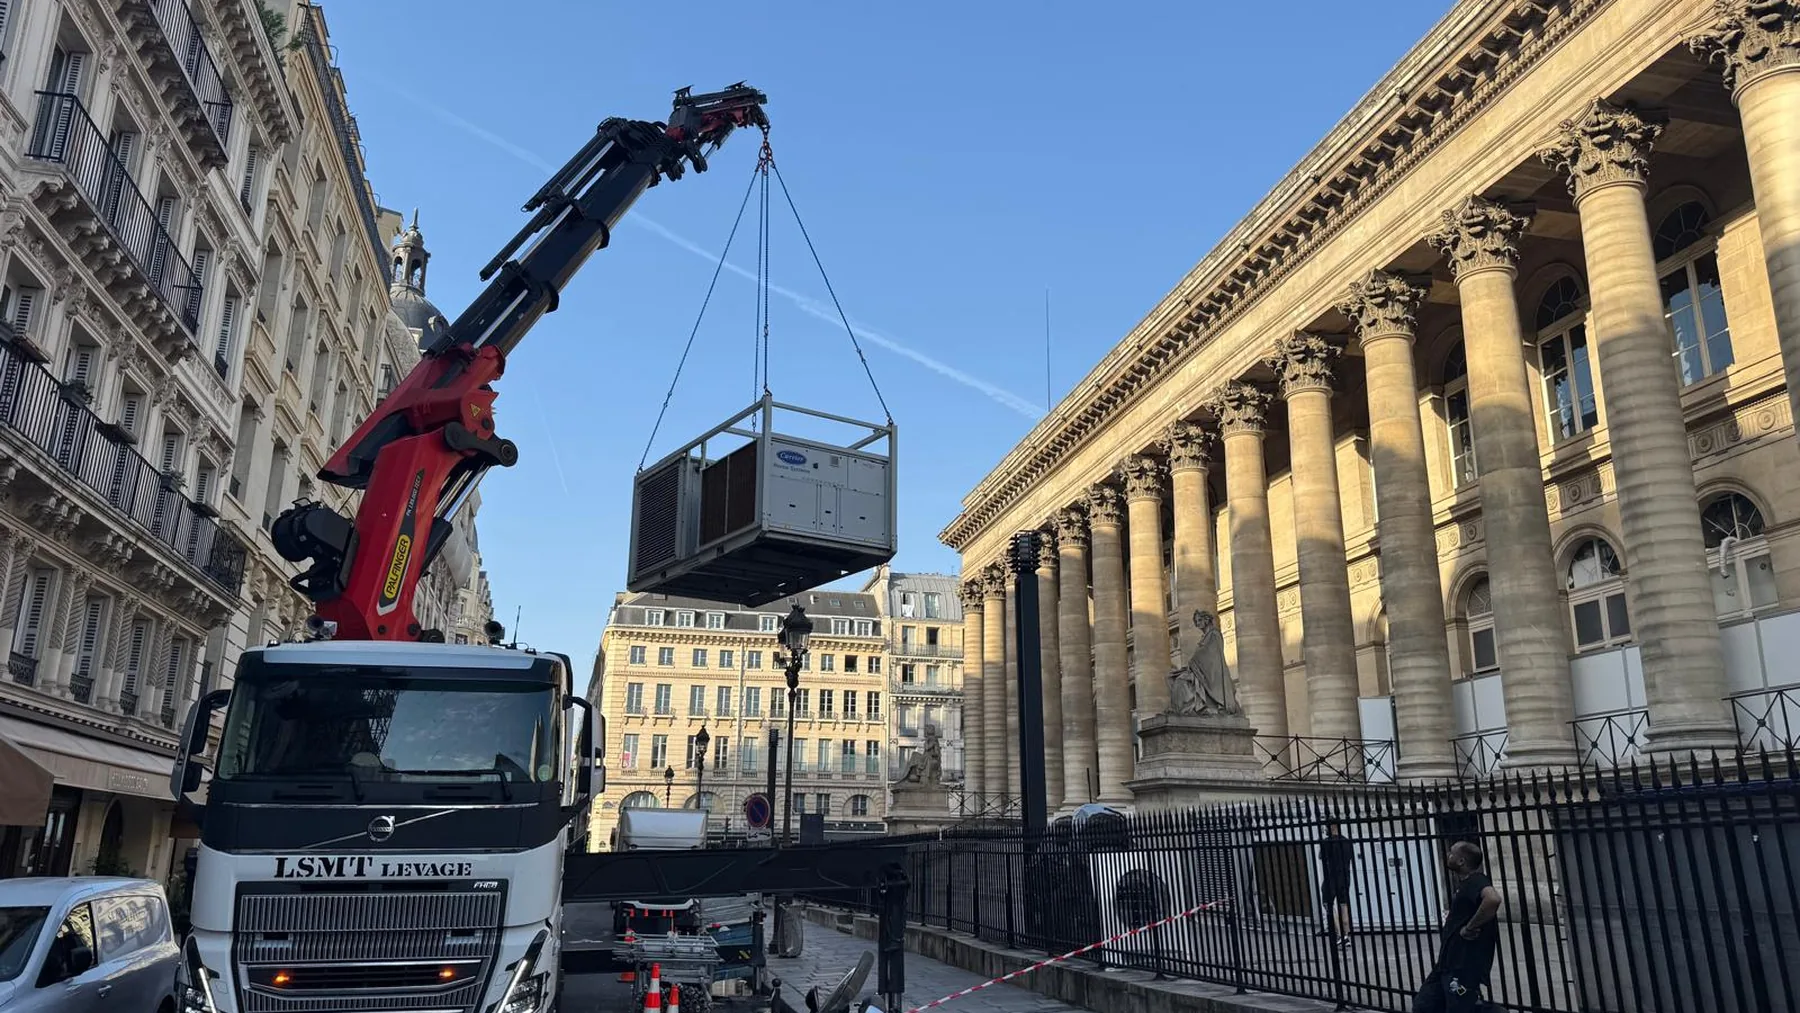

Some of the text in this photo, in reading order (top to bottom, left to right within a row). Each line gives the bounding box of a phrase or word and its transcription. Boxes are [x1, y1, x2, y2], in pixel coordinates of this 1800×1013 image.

[386, 538, 409, 596] PALFINGER
[274, 857, 472, 878] LSMT LEVAGE
